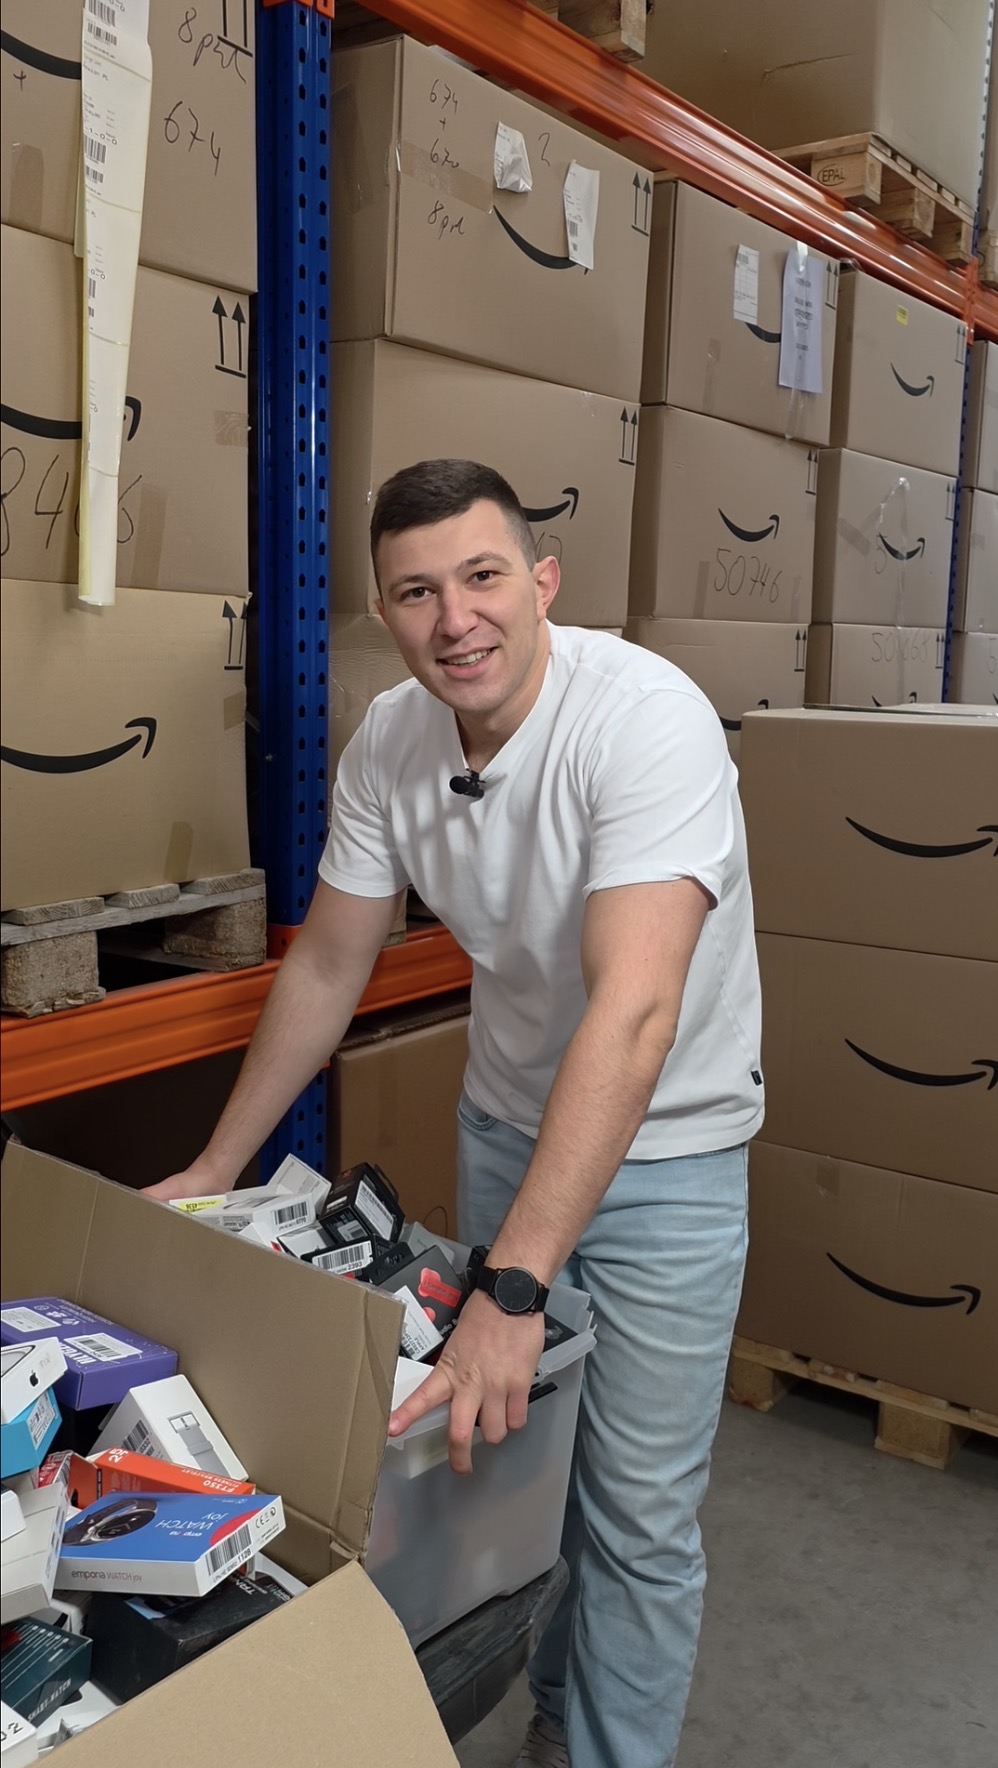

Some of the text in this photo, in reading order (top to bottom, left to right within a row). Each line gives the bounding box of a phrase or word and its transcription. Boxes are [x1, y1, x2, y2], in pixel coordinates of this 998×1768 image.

[164, 100, 221, 176] 674
[822, 168, 846, 183] EPAL
[714, 547, 783, 604] 50746
[155, 1519, 214, 1530] WATCH
[71, 1570, 143, 1583] emporia WATCH joy
